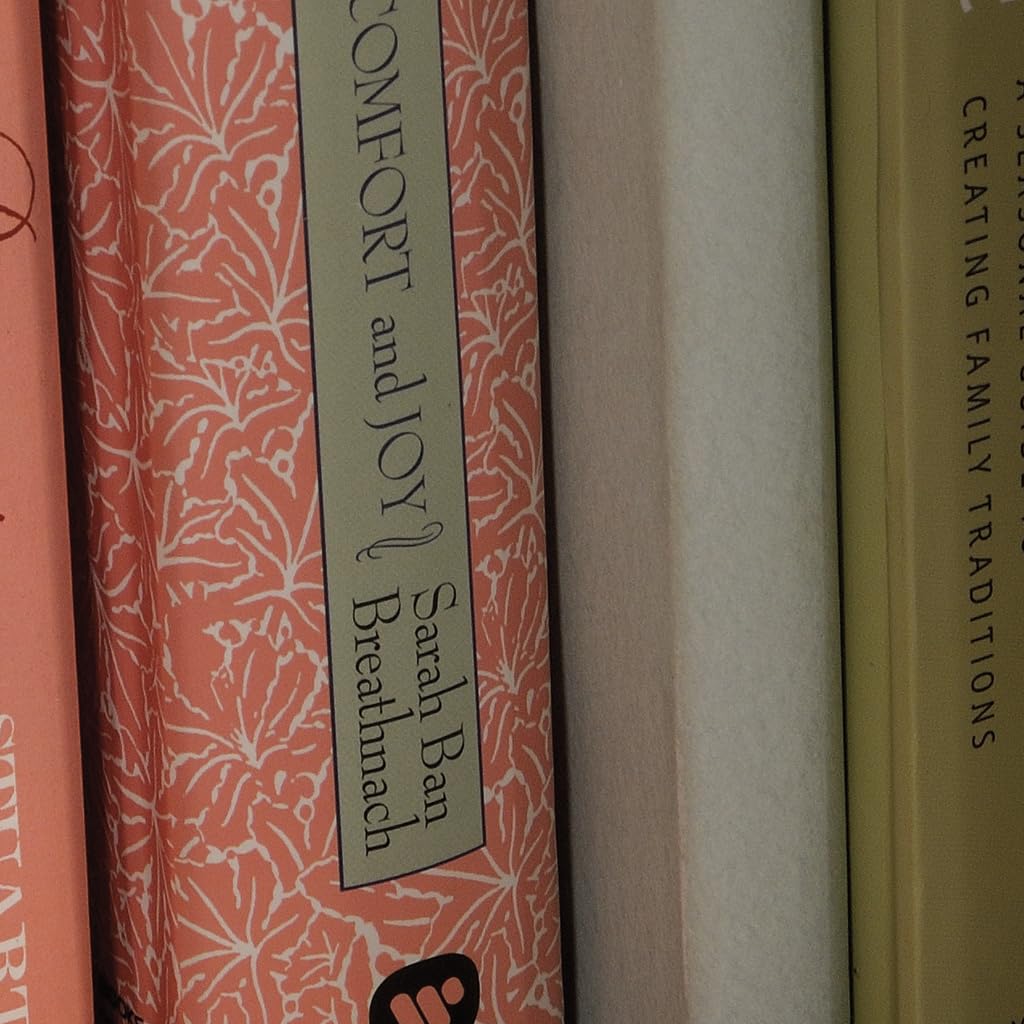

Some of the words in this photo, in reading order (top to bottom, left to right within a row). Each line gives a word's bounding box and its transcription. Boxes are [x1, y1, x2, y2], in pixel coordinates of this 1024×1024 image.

[962, 95, 990, 307] CREATING
[371, 315, 427, 404] and
[966, 327, 992, 473] FAMILY
[363, 404, 427, 516] JOY
[410, 581, 468, 723] Sarah
[969, 494, 996, 749] TRADITIONS
[352, 586, 421, 857] Breathnach
[421, 722, 465, 829] Ban
